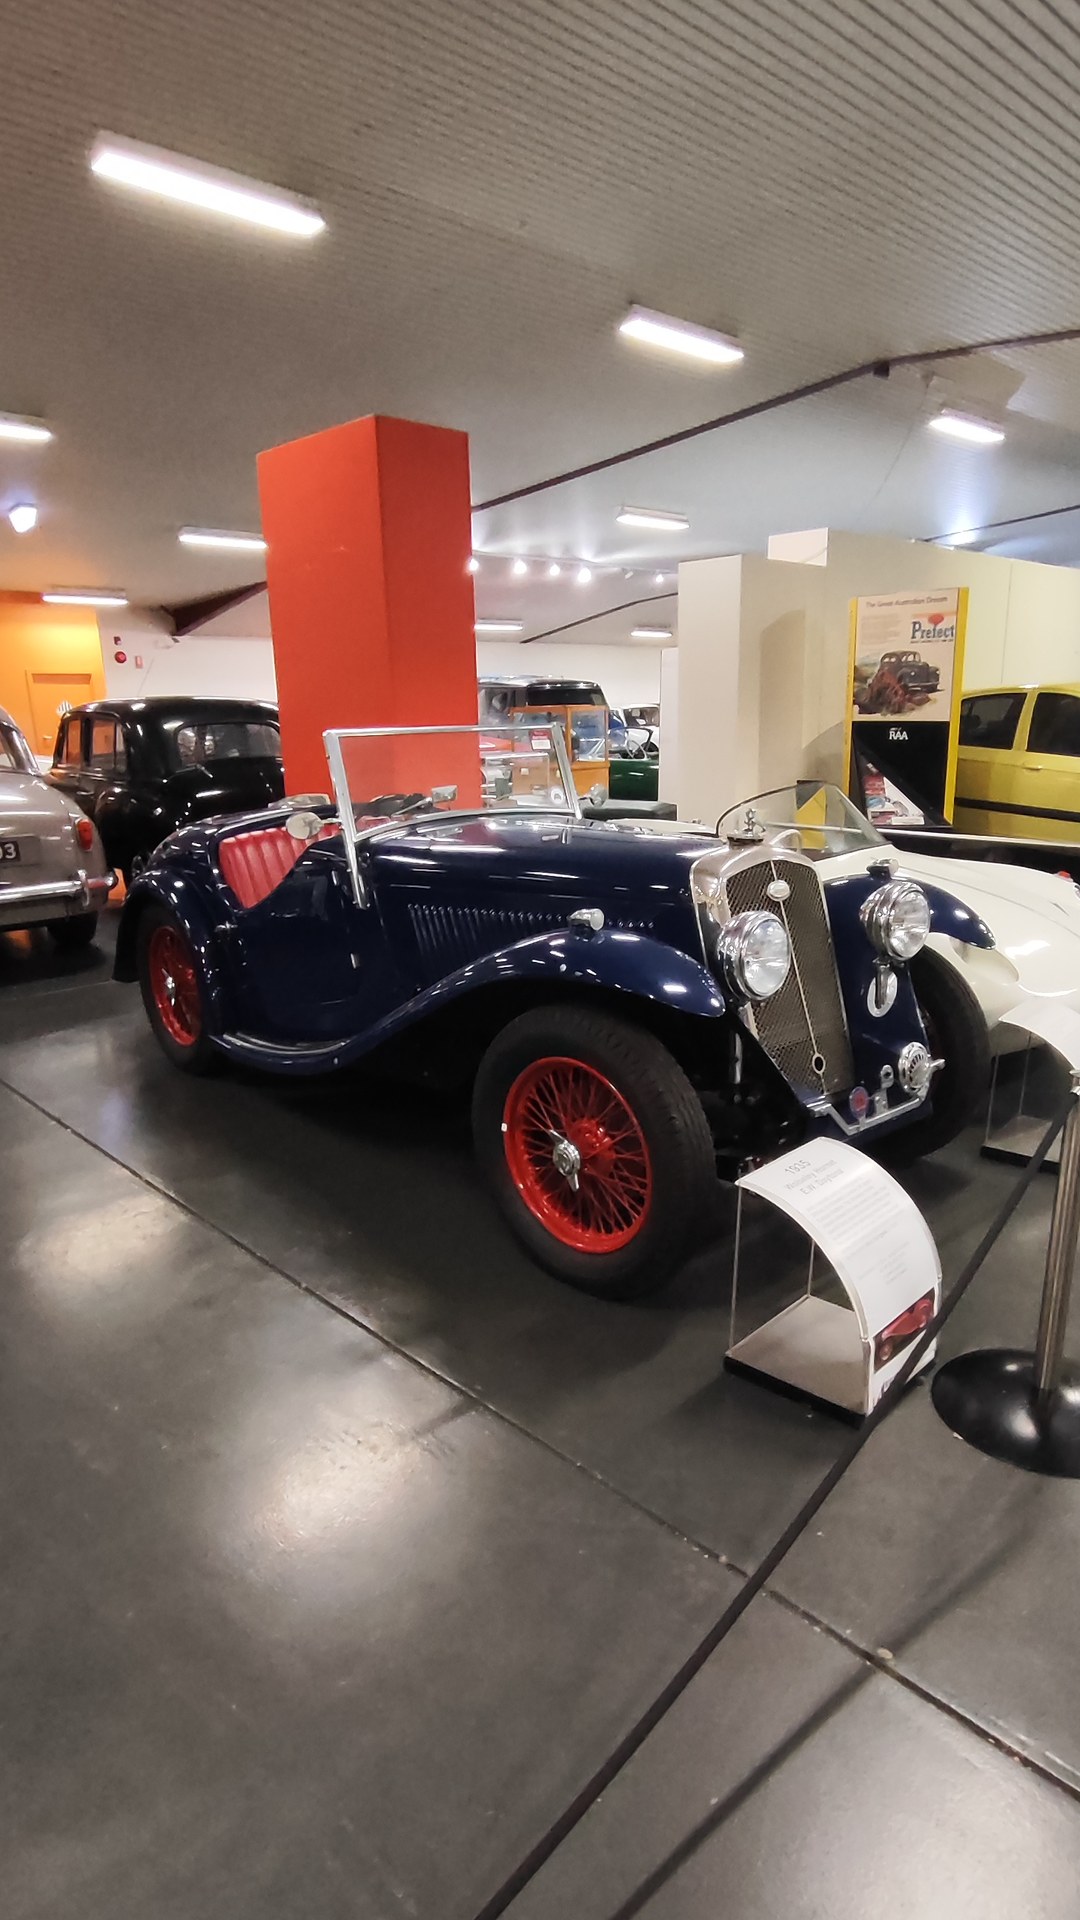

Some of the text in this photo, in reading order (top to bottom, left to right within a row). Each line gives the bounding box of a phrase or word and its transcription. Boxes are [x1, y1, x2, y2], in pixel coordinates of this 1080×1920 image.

[911, 621, 954, 639] Prefect
[889, 731, 908, 740] RAA
[0, 843, 17, 859] 3
[784, 1159, 812, 1175] 1935
